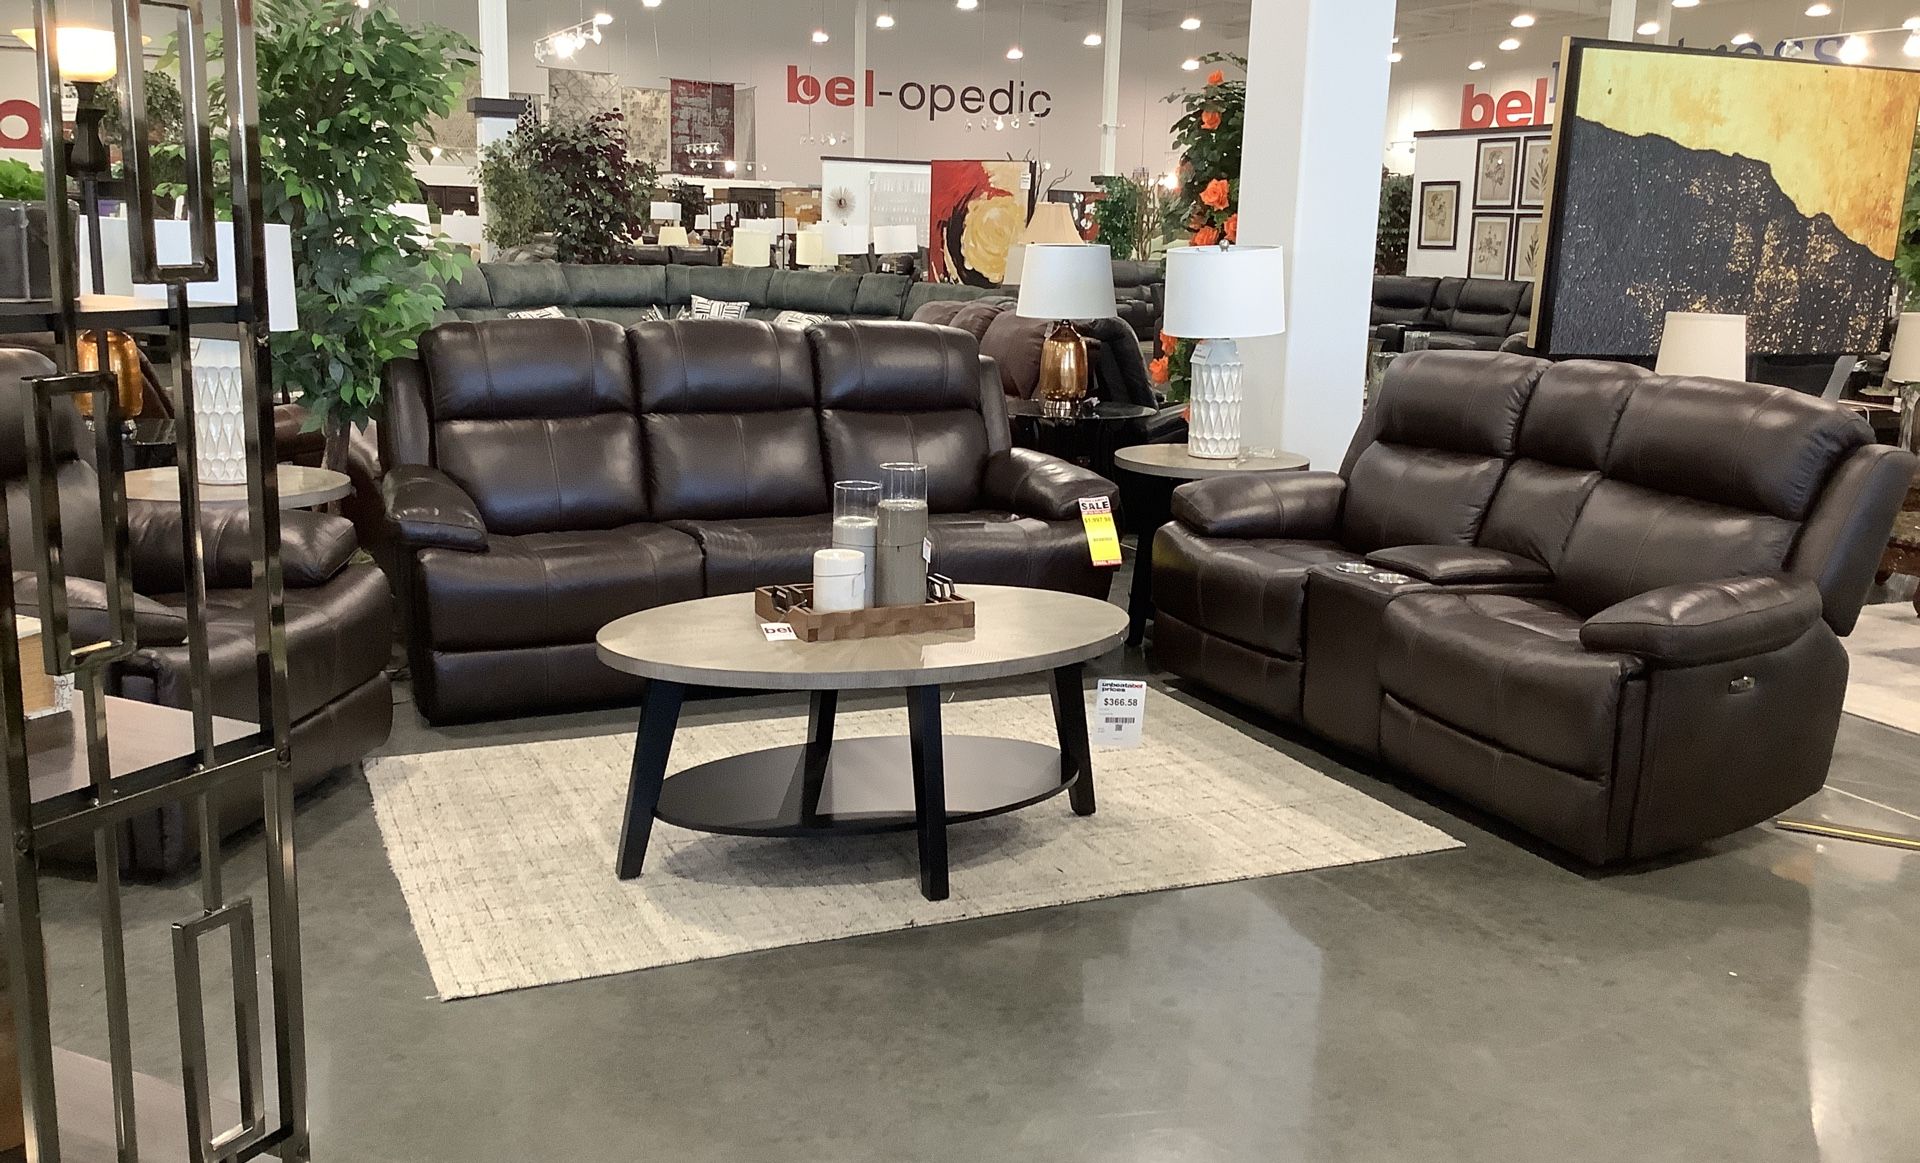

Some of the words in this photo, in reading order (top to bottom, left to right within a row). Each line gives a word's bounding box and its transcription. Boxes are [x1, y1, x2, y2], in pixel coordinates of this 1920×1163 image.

[1460, 78, 1548, 128] bel
[1081, 501, 1109, 510] SALE
[1104, 698, 1138, 706] $366.58
